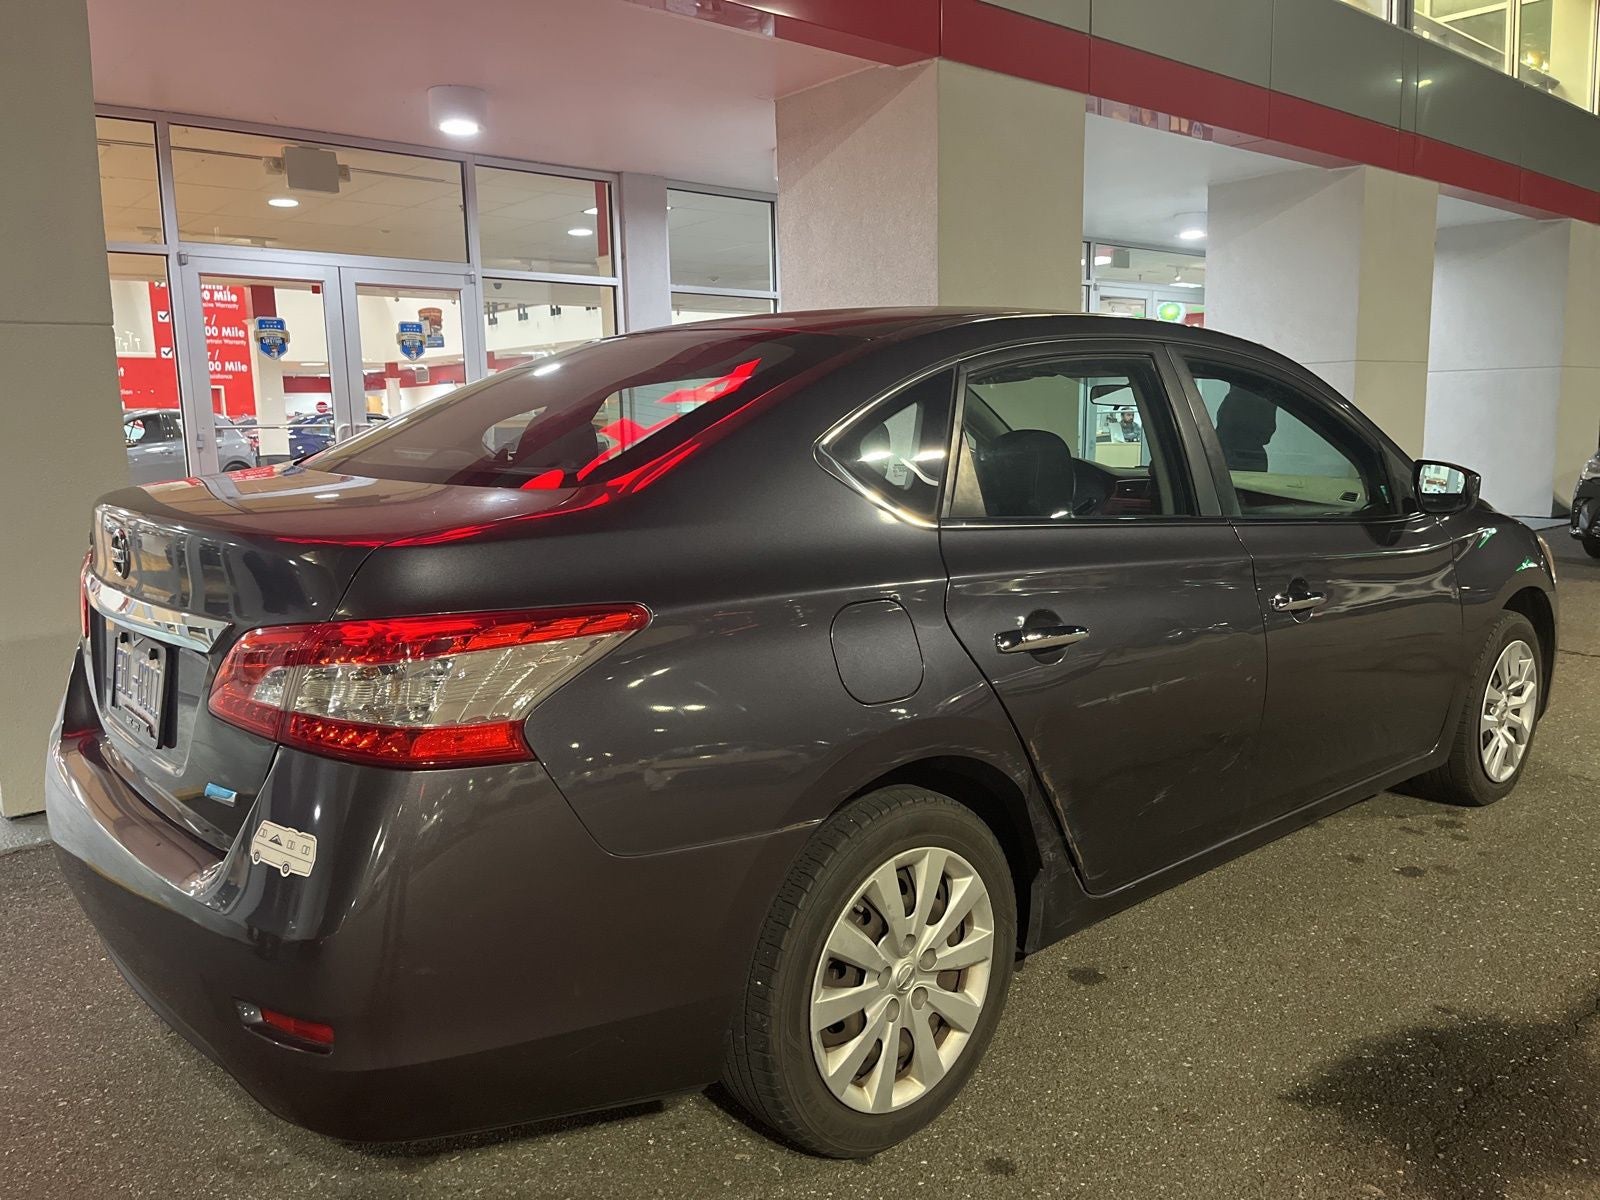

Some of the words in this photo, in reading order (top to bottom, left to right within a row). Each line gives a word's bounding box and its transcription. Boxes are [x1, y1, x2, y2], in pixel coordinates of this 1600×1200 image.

[214, 291, 237, 302] Mile
[222, 327, 245, 337] Mile
[225, 361, 247, 372] Mile
